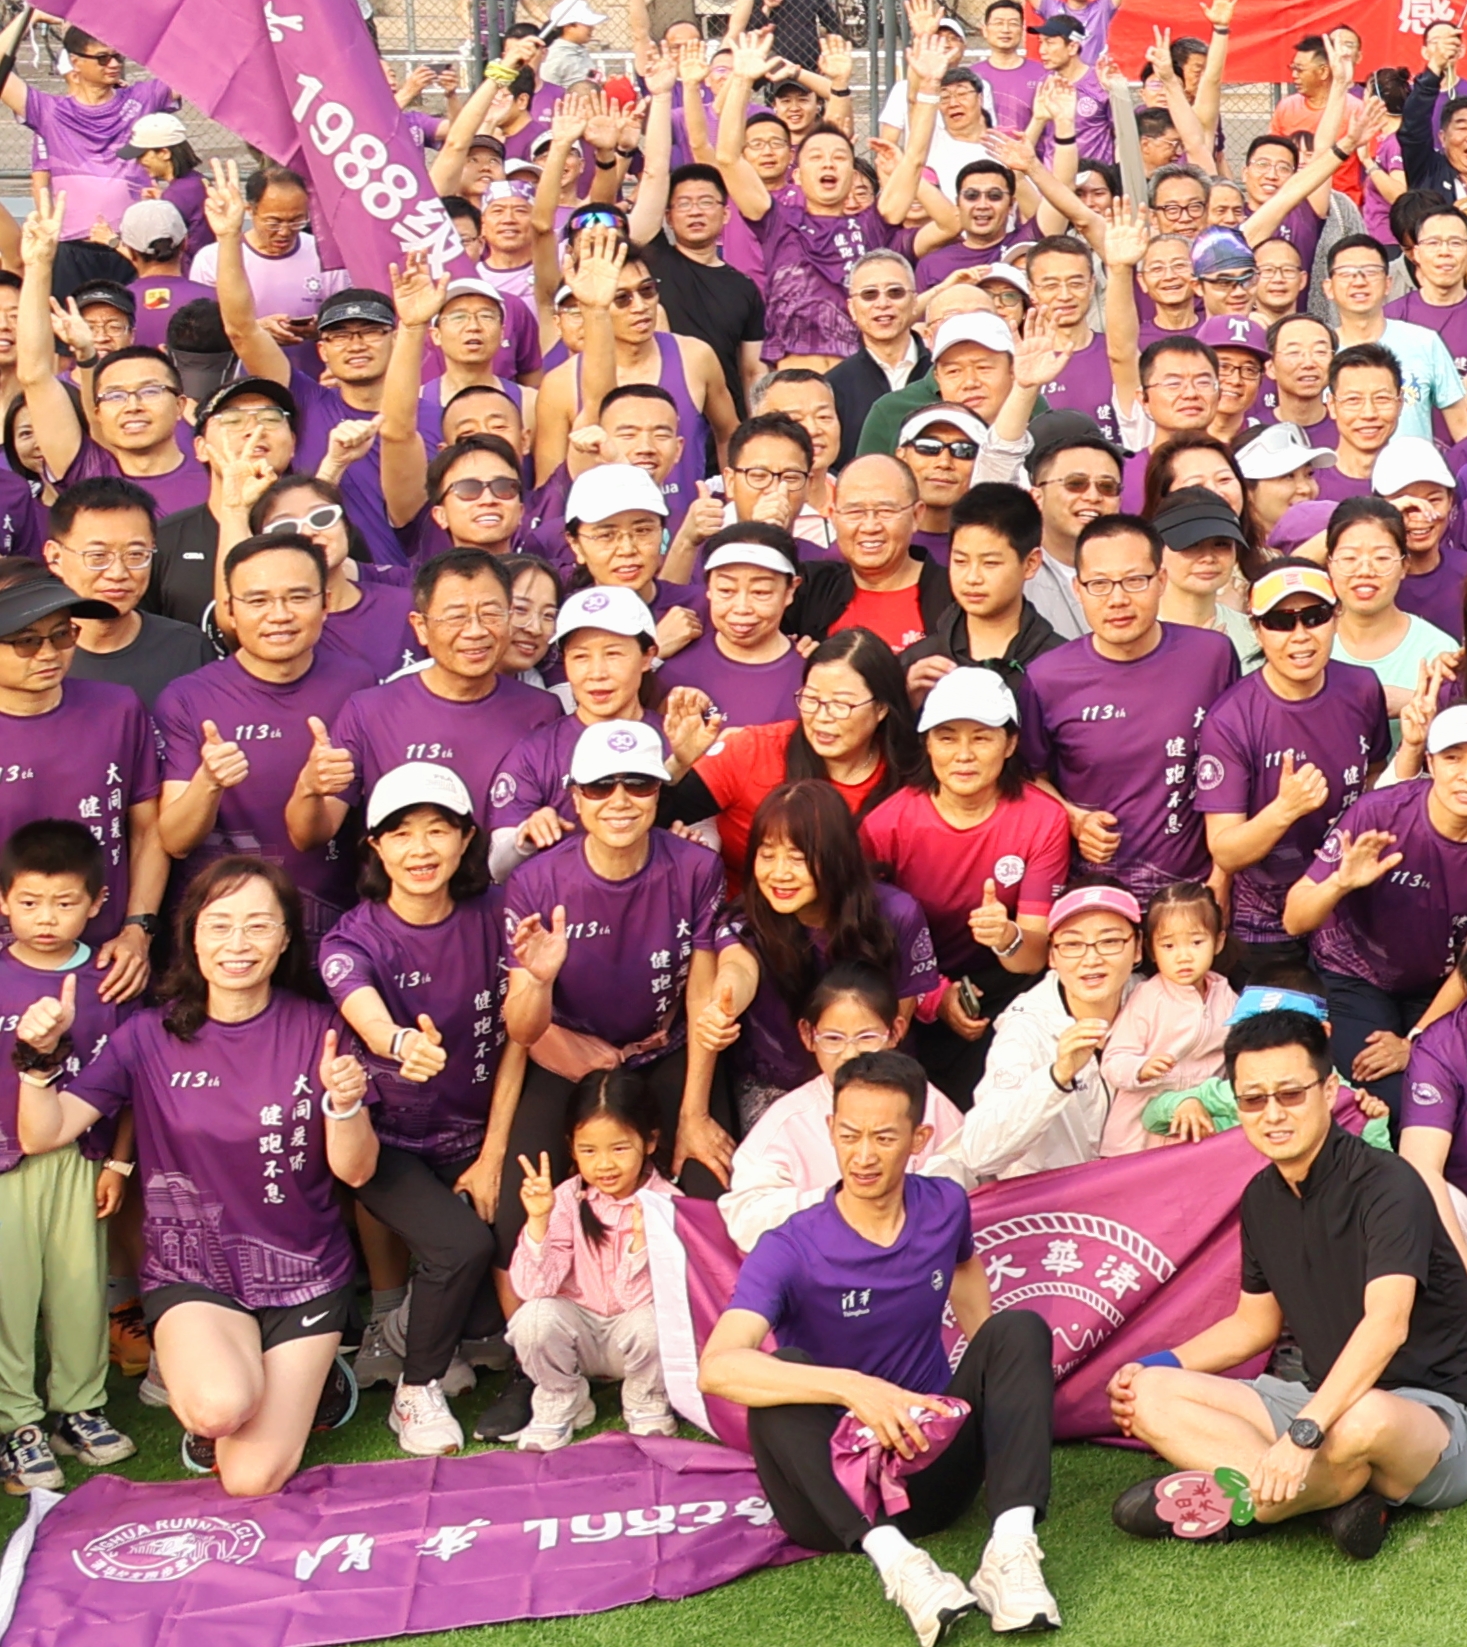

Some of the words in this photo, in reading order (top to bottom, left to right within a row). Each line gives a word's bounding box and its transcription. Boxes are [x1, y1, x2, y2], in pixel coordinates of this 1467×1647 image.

[1082, 705, 1126, 722] 113th
[235, 722, 283, 741] 113th
[406, 743, 454, 760] 113th
[1165, 738, 1186, 836] 健跑不息
[1391, 871, 1431, 888] 113th
[567, 922, 610, 938] 113th
[169, 1073, 221, 1089] 113th
[259, 1104, 284, 1207] 健跑不息
[843, 1309, 870, 1318] Tsinghua
